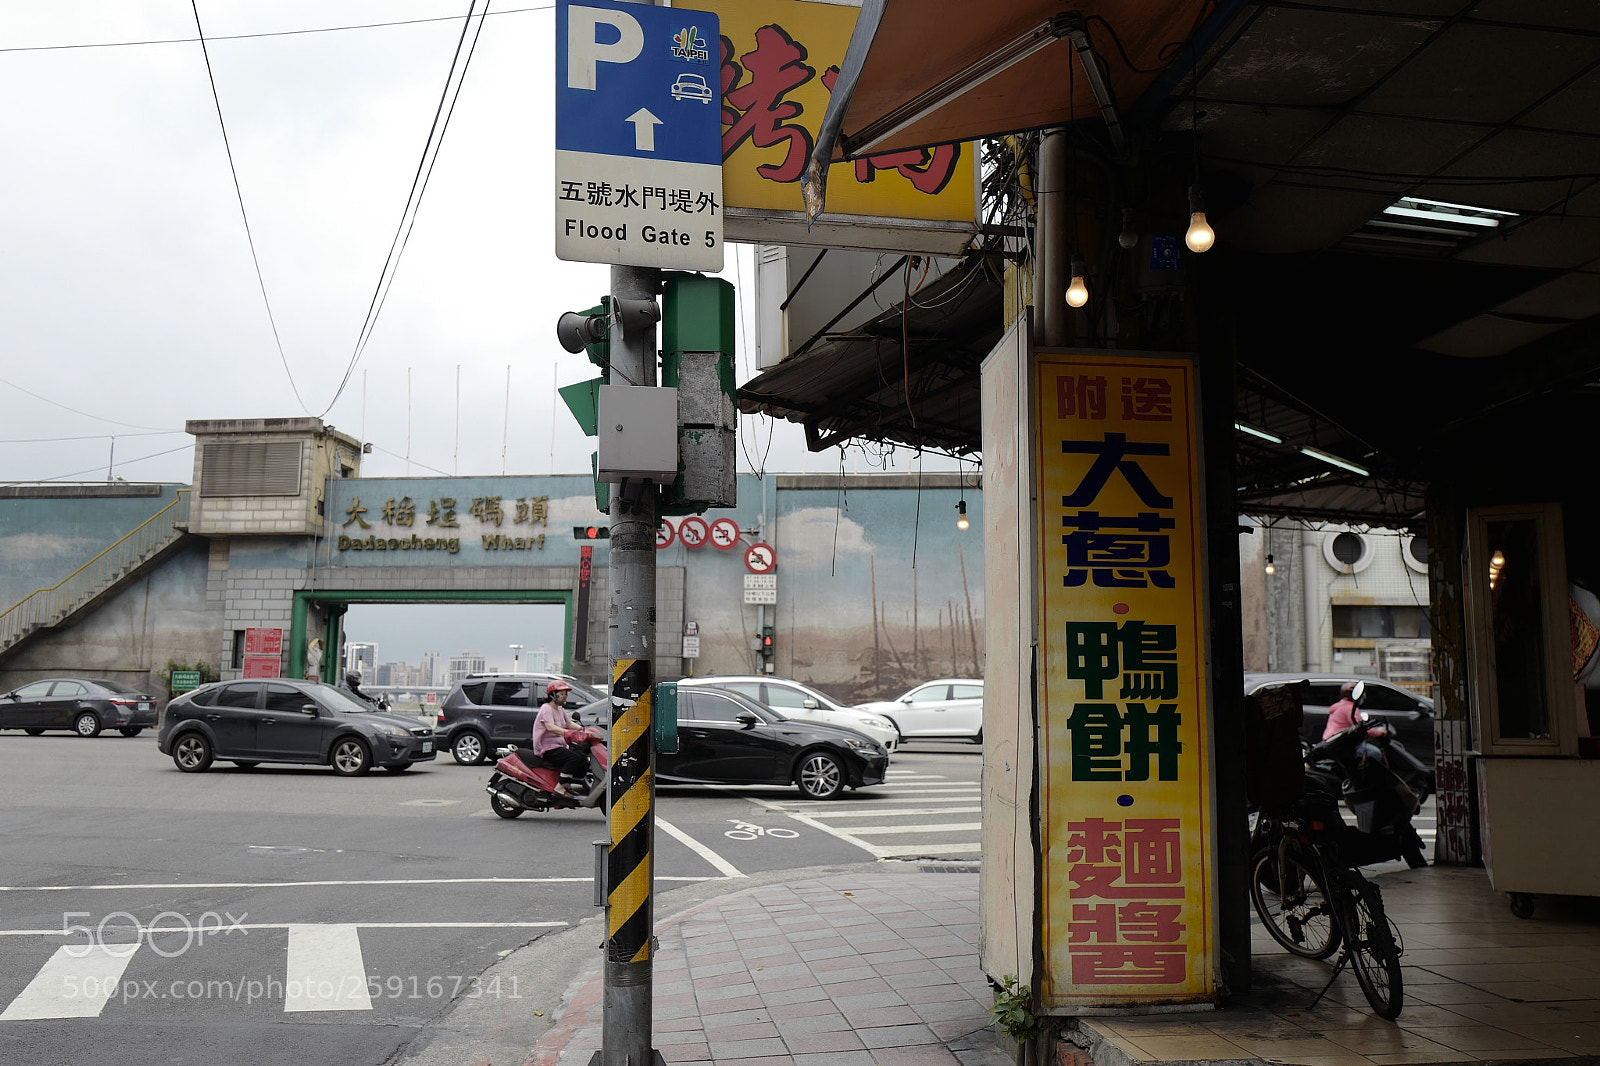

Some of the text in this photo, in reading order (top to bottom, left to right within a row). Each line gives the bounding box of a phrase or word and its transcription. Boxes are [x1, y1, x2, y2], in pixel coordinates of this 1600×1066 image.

[567, 4, 644, 91] P
[670, 46, 709, 60] TAIPEI
[559, 180, 720, 216] 五號水門堤外
[565, 218, 716, 248] Flood Gate 5
[1055, 375, 1173, 422] 附送
[342, 495, 549, 529] 大稻埕碼頭
[337, 534, 546, 555] Dadaocheng Wharf
